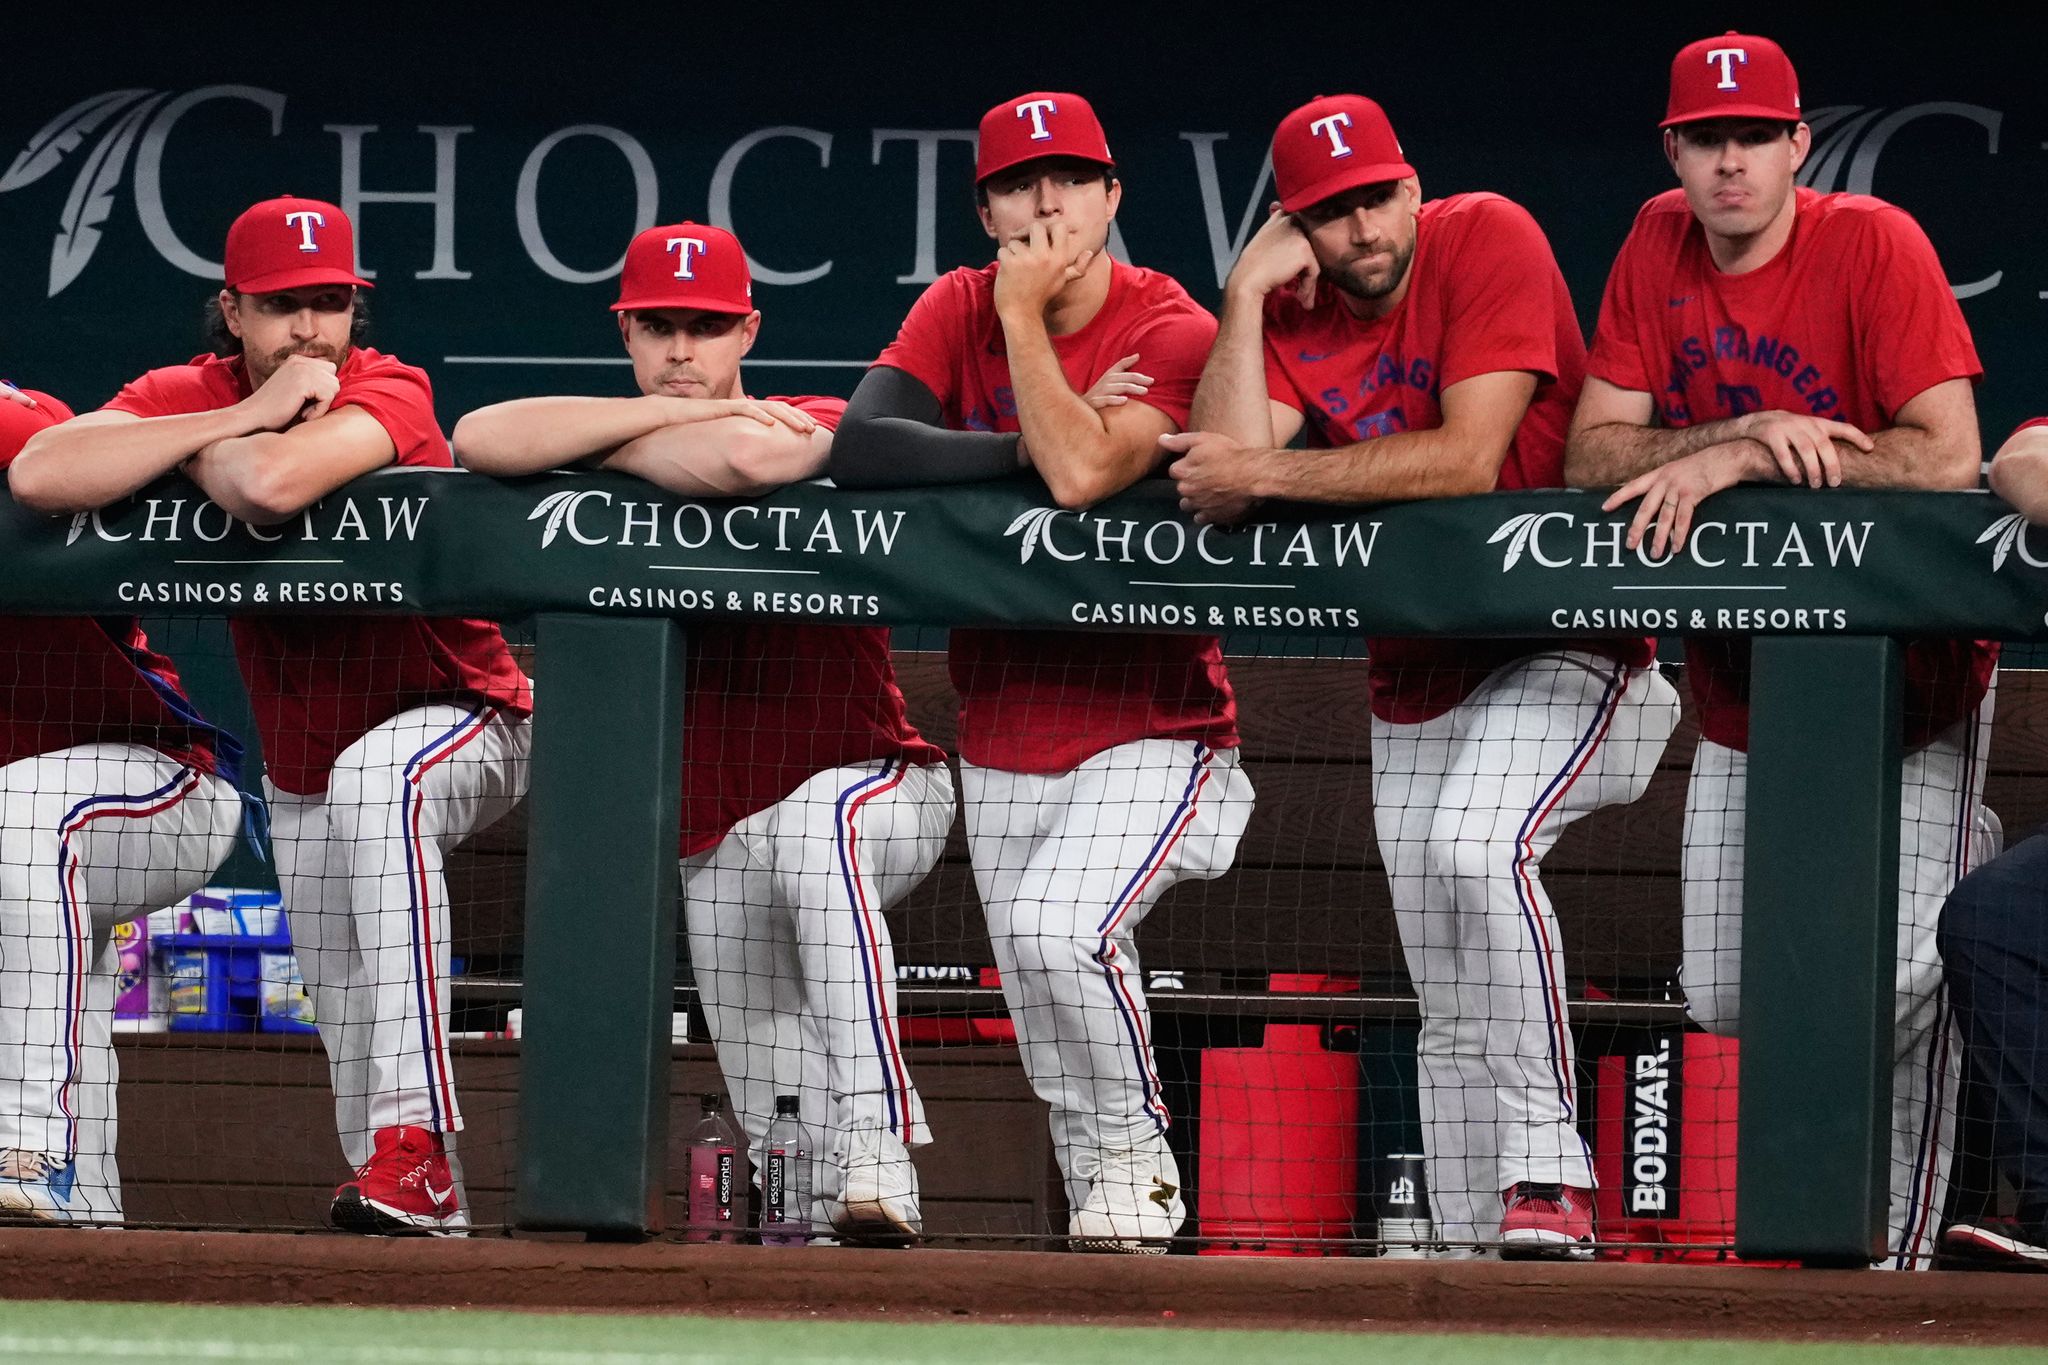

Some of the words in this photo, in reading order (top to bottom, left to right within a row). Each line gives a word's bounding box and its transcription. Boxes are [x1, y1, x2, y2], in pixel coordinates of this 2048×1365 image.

[1706, 48, 1747, 91] T
[1016, 99, 1059, 140] T
[1310, 112, 1353, 160] T
[285, 211, 325, 253] T
[666, 237, 706, 280] T
[1714, 325, 1847, 423] RANGER
[565, 490, 906, 556] CHOCTAW
[1041, 509, 1383, 567] CHOCTAW
[1529, 512, 1875, 568] CHOCTAW
[118, 582, 242, 603] CASINOS
[253, 582, 269, 603] &
[279, 582, 404, 603] RESORTS
[588, 586, 714, 610] CASINOS
[726, 590, 743, 611] &
[753, 591, 880, 616] RESORTS
[1071, 602, 1197, 625] CASINOS
[1207, 605, 1225, 626] &
[1234, 606, 1360, 628] RESORTS
[1551, 608, 1678, 629] CASINOS
[1689, 608, 1706, 629] &
[1717, 608, 1847, 630] RESORTS
[720, 1156, 732, 1203] essentia
[769, 1158, 780, 1205] essentia
